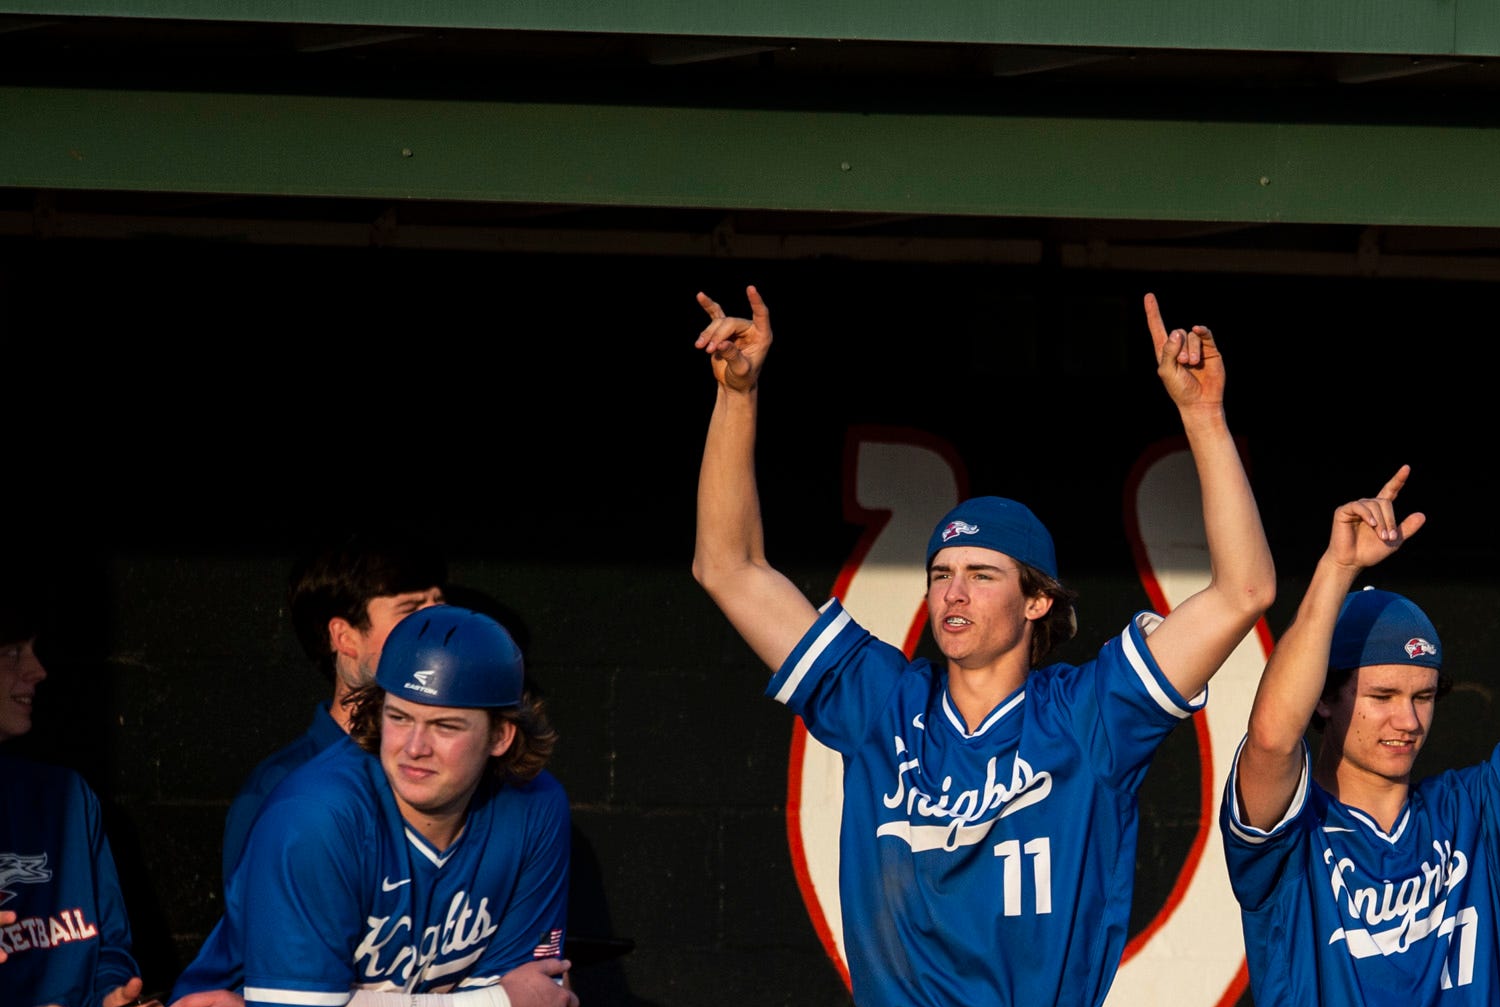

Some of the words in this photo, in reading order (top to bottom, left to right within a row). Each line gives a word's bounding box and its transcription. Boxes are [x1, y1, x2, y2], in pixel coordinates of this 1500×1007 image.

[882, 736, 1048, 852] Knighs
[993, 837, 1052, 916] 11
[354, 890, 499, 994] Knghts
